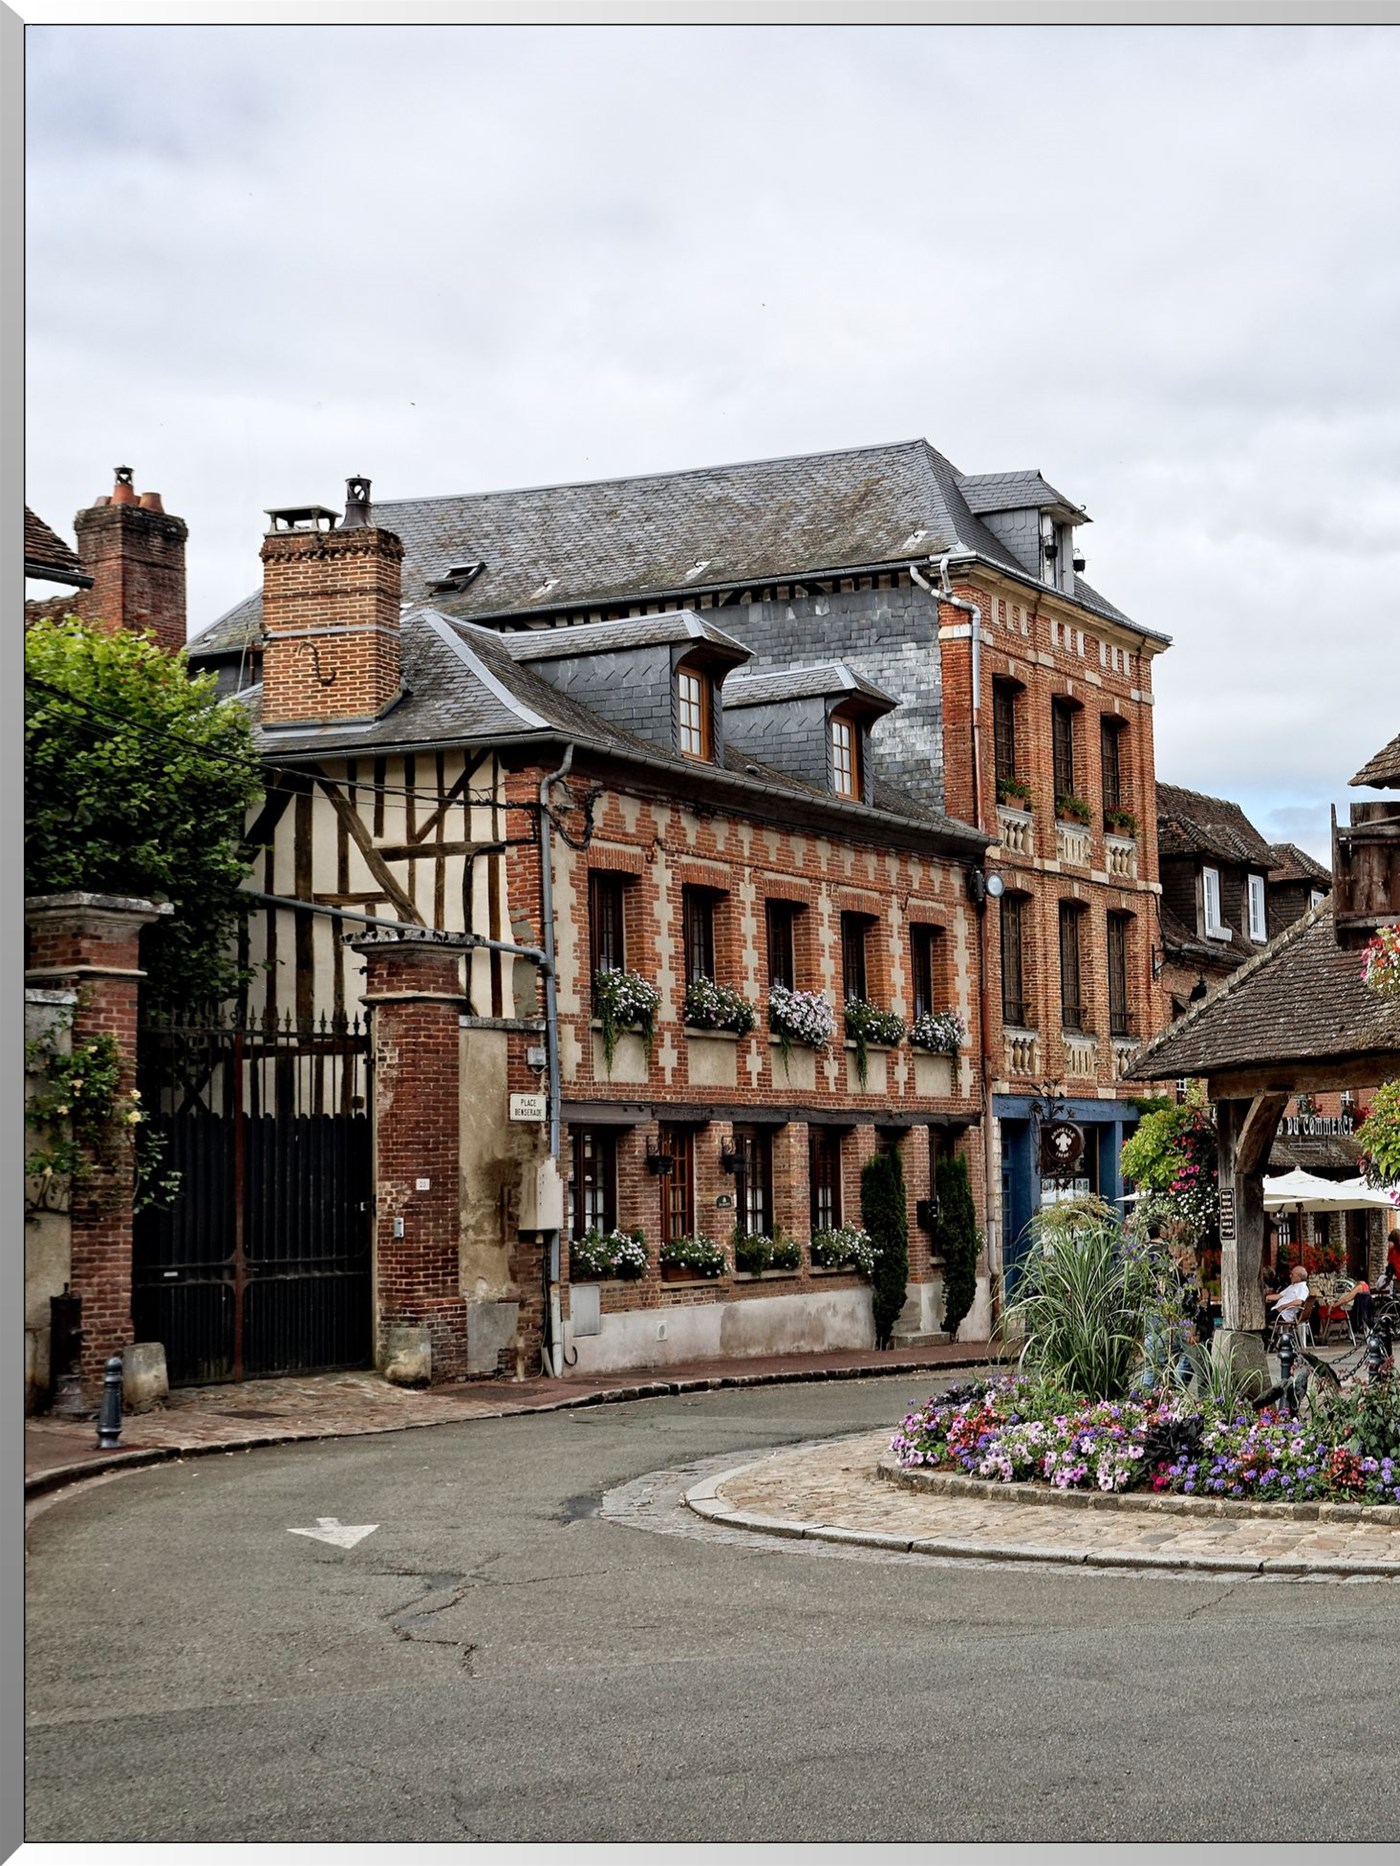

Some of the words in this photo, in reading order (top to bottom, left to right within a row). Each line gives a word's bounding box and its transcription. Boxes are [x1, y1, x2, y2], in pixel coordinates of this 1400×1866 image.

[520, 1099, 536, 1107] PLACE
[514, 1108, 542, 1117] BENSERADE
[1286, 1117, 1299, 1135] DU
[1302, 1115, 1353, 1135] COMMERCE
